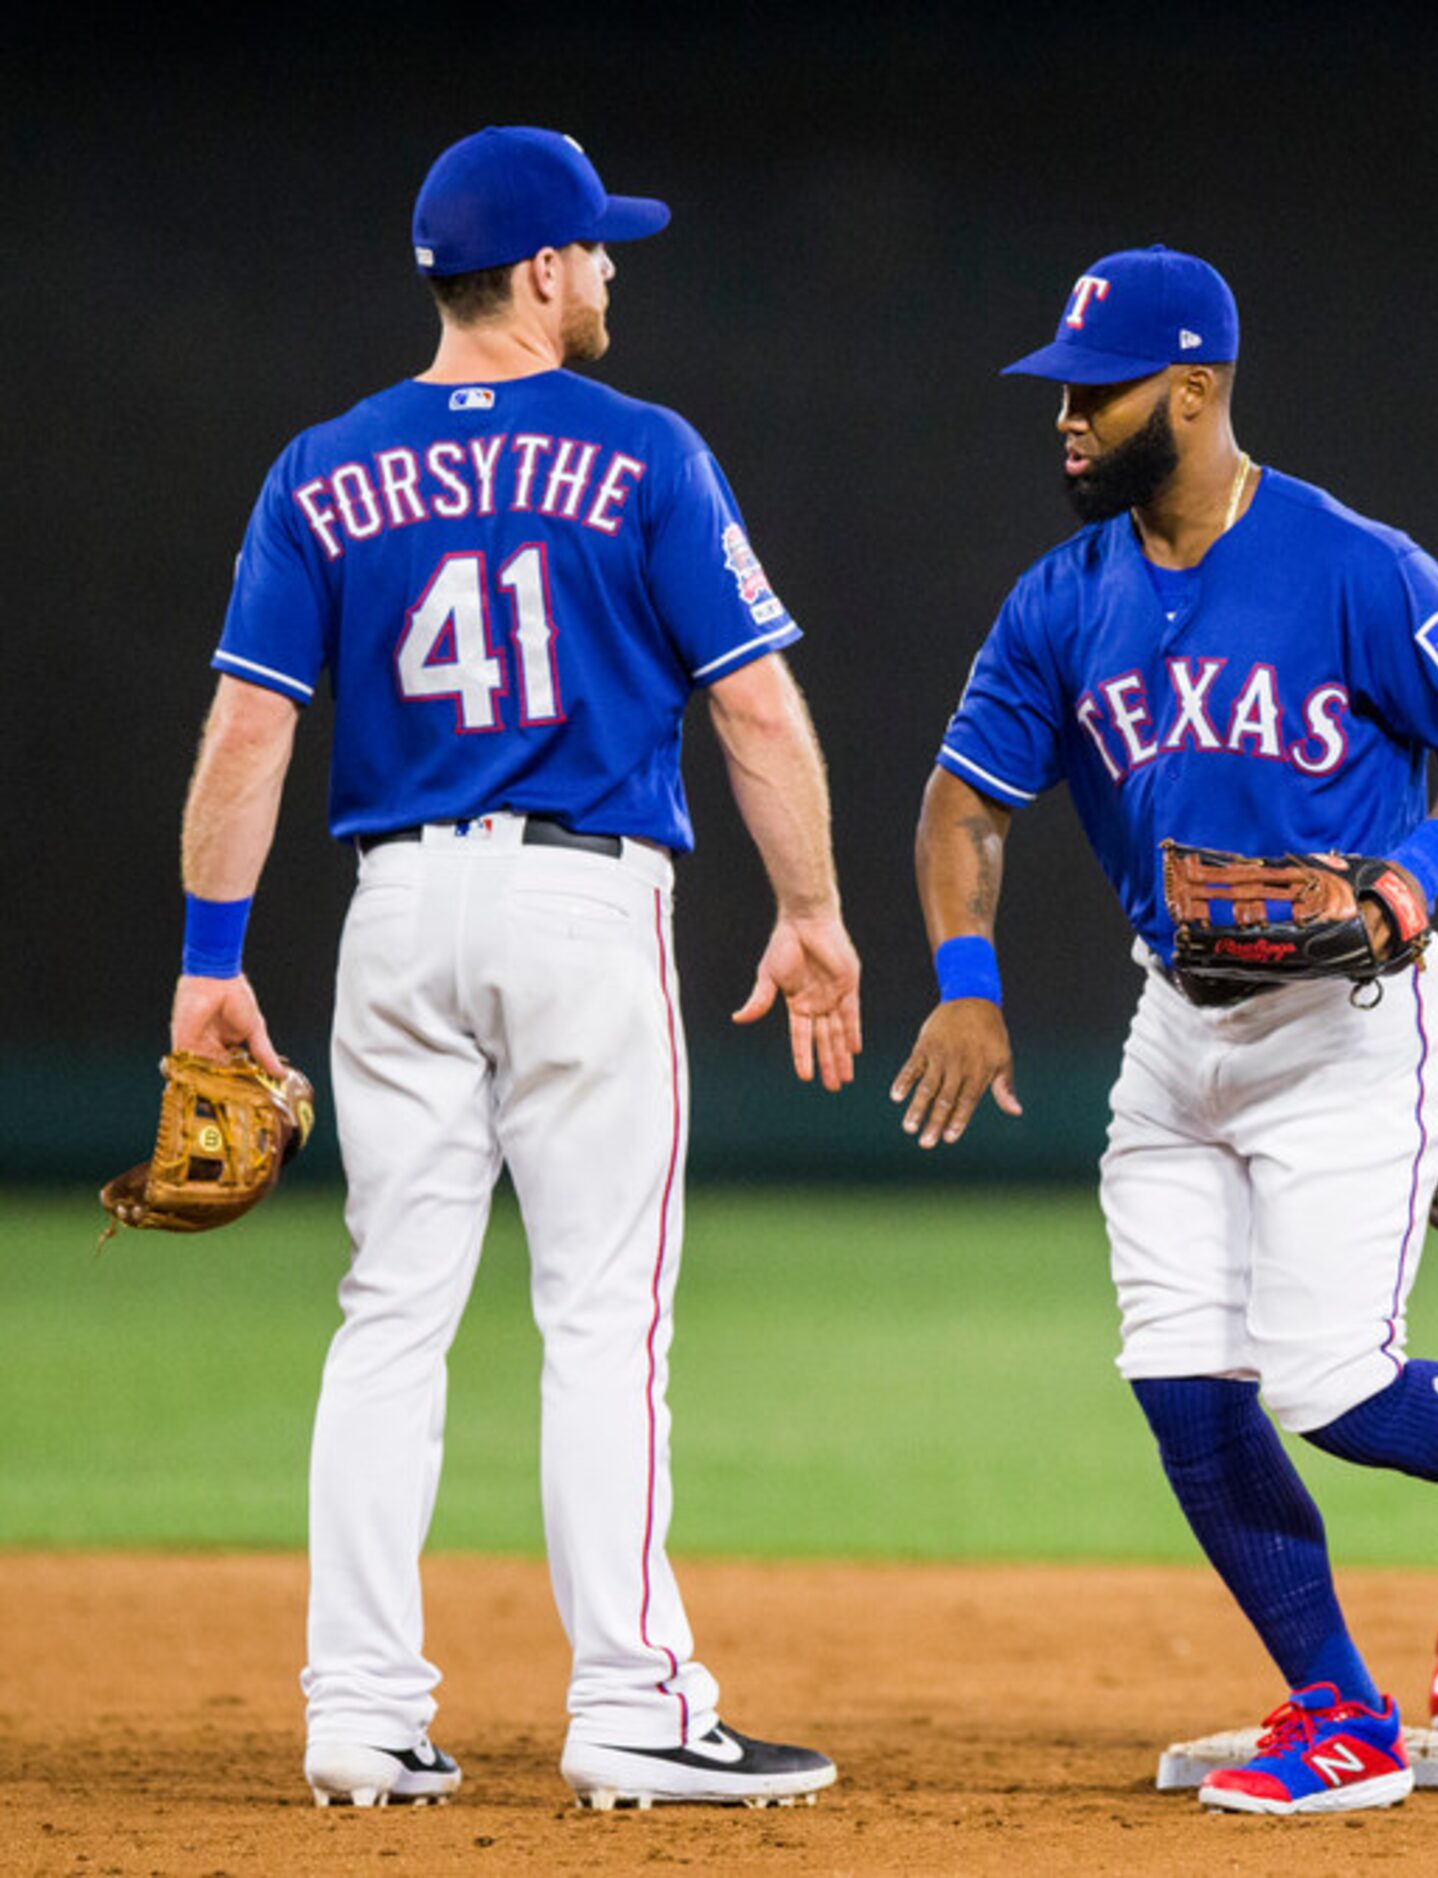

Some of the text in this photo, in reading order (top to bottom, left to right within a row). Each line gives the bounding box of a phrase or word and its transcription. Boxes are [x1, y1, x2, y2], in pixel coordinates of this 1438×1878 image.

[1066, 275, 1111, 329] T
[293, 433, 646, 560] FORSYTHE
[395, 542, 567, 734] 41
[1075, 656, 1350, 784] TEXAS
[1311, 1743, 1364, 1786] N
